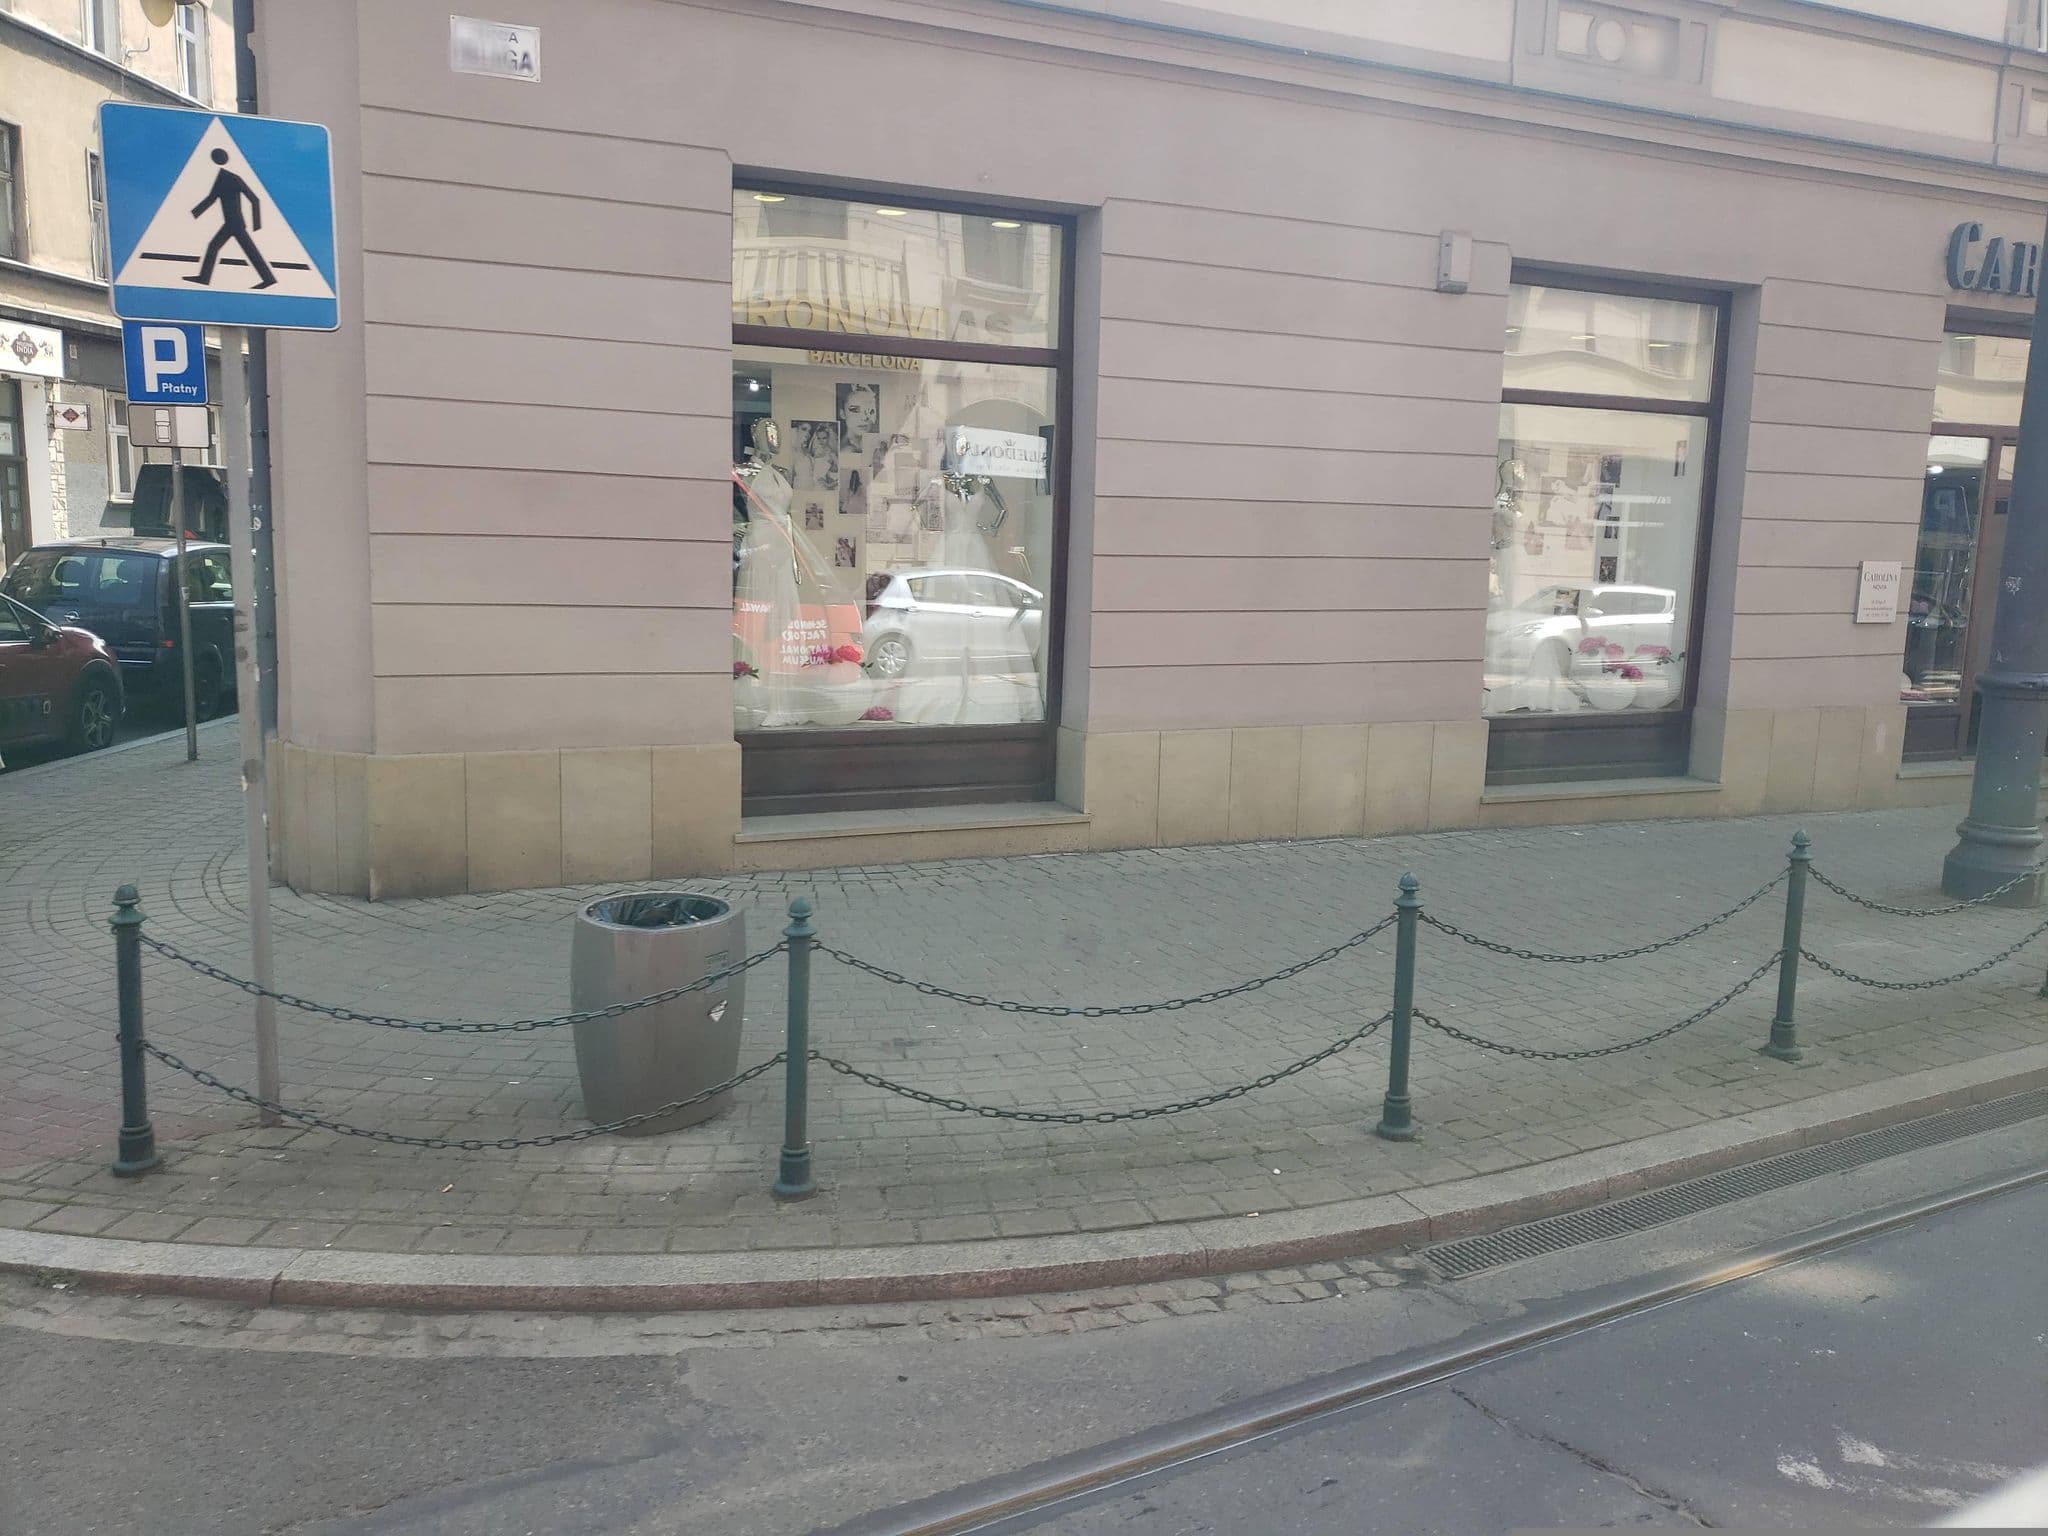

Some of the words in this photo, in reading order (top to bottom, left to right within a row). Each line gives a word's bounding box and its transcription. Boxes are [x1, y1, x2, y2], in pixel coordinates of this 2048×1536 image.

[16, 344, 34, 356] INDIA
[141, 326, 188, 393] P
[809, 349, 920, 371] BARCELONA
[161, 382, 198, 397] Płatny
